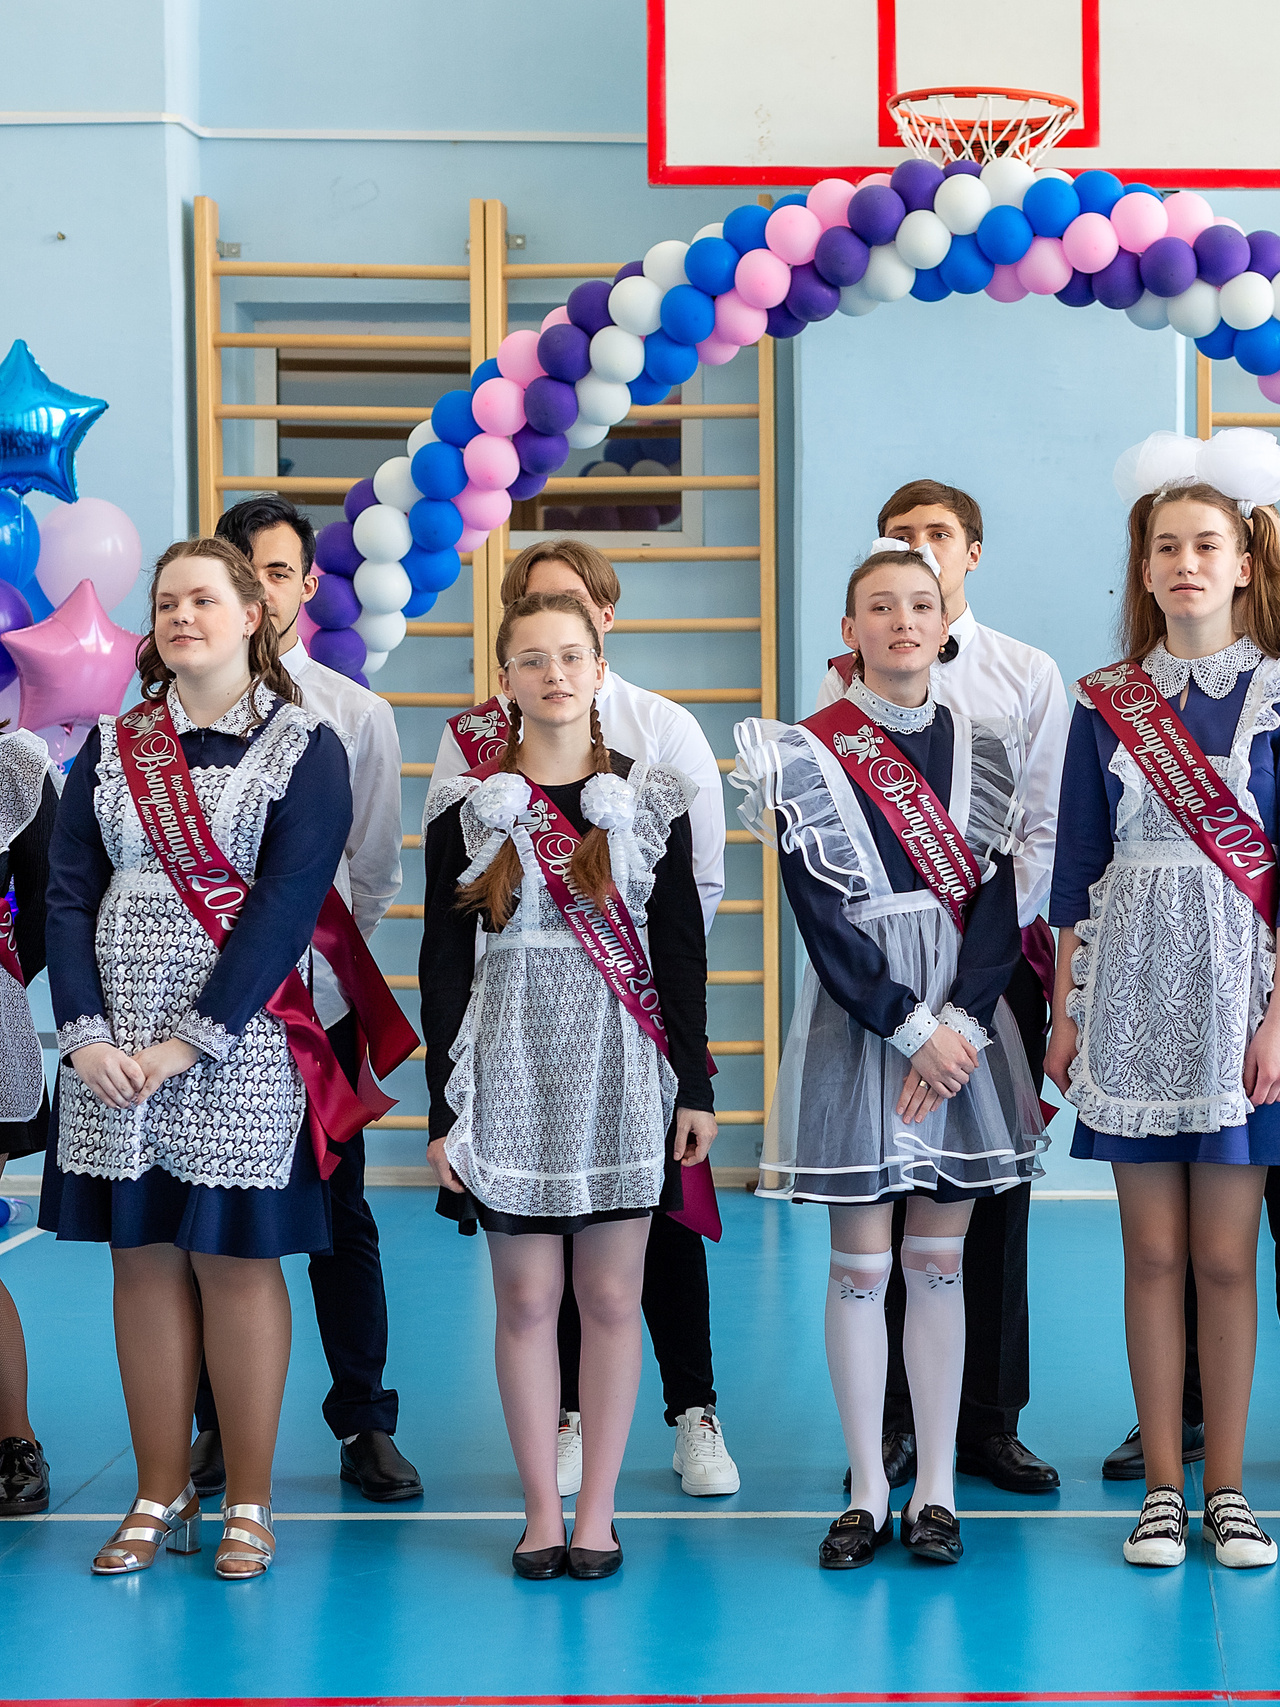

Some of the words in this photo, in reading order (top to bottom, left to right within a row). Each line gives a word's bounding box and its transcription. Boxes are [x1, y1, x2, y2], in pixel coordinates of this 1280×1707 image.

[1111, 681, 1206, 814] Выпускница
[1151, 773, 1166, 789] СОШ
[1159, 717, 1197, 766] Коробкова
[1192, 767, 1220, 799] Арина
[132, 730, 197, 871] Выпускница
[148, 825, 161, 841] СОШ
[170, 774, 190, 813] Корбань
[184, 815, 213, 862] Наталья
[868, 757, 967, 901] Выпускница
[917, 794, 947, 831] Ларина
[942, 832, 977, 889] Анастасия
[917, 858, 932, 874] СОШ
[1196, 806, 1277, 880] 2021
[186, 868, 244, 931] 202
[581, 933, 596, 949] СОШ
[619, 925, 643, 966] Наталья
